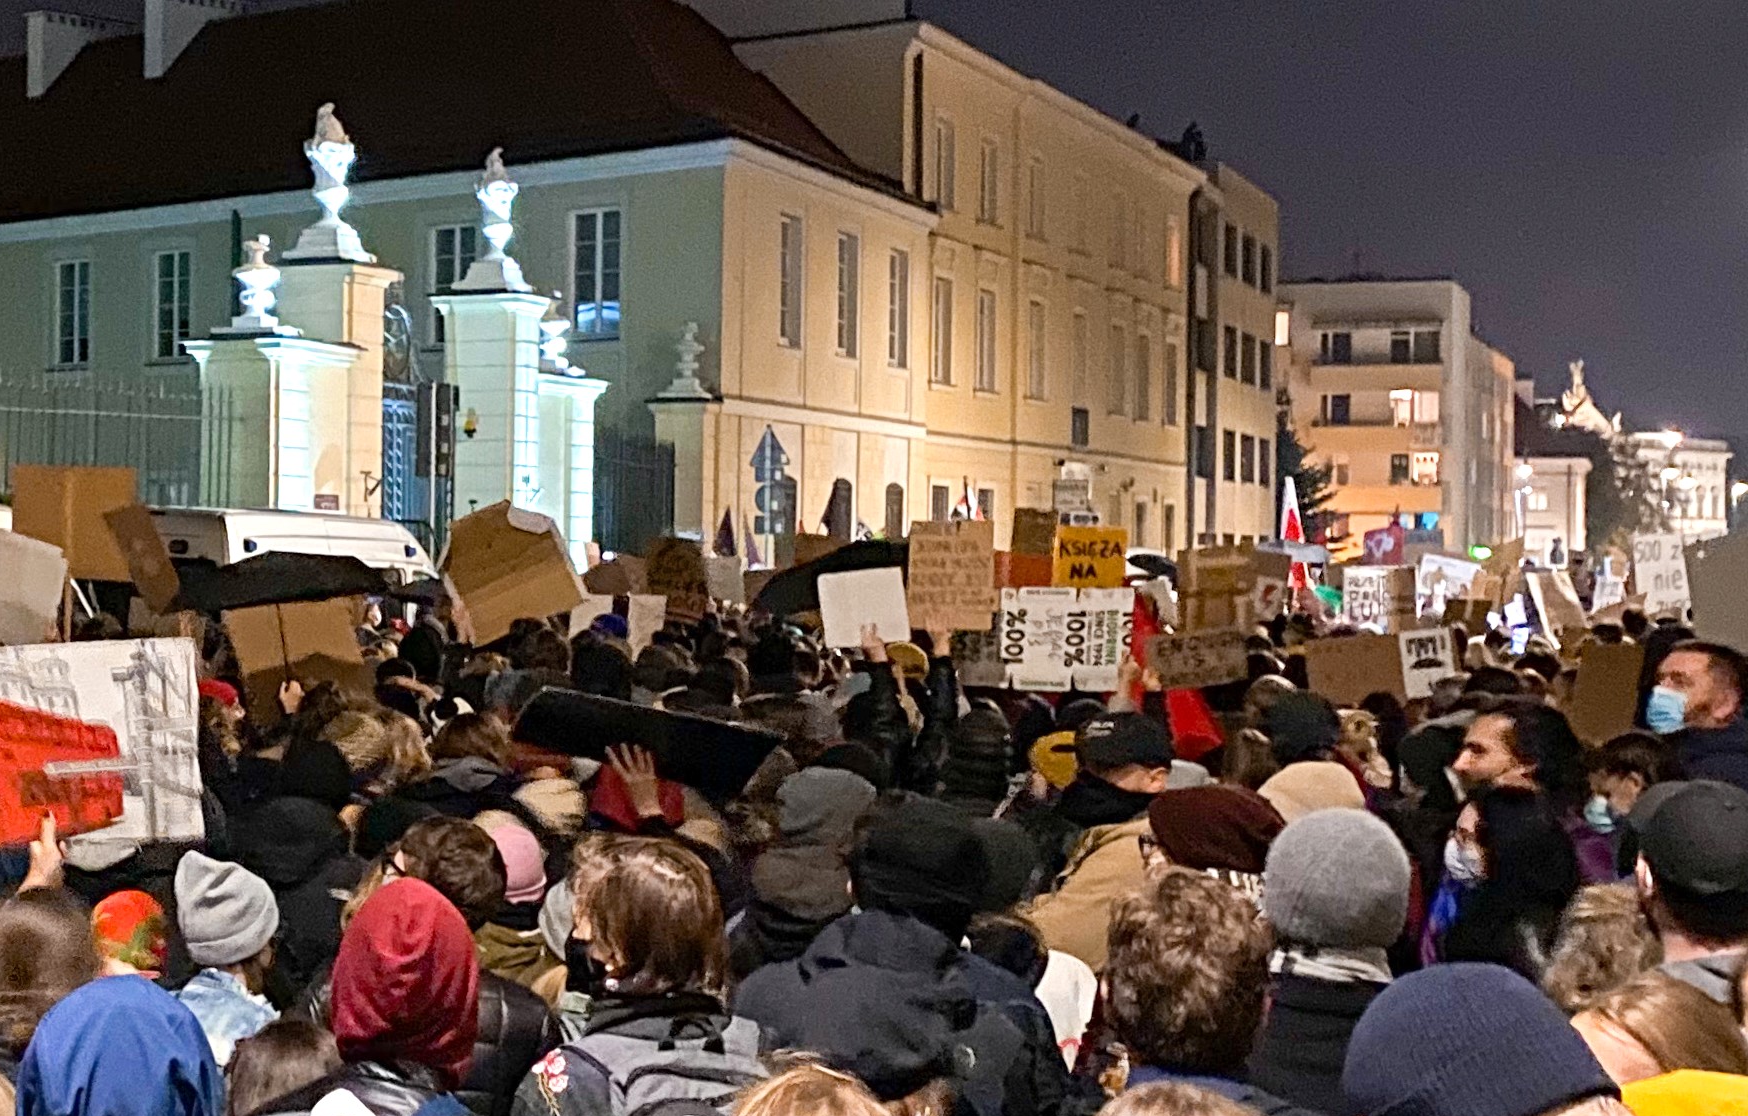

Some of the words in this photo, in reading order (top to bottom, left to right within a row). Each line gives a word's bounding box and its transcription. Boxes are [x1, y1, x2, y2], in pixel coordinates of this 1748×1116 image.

[1069, 563, 1097, 580] NA
[1002, 608, 1028, 664] 100%
[1064, 610, 1087, 668] 100%
